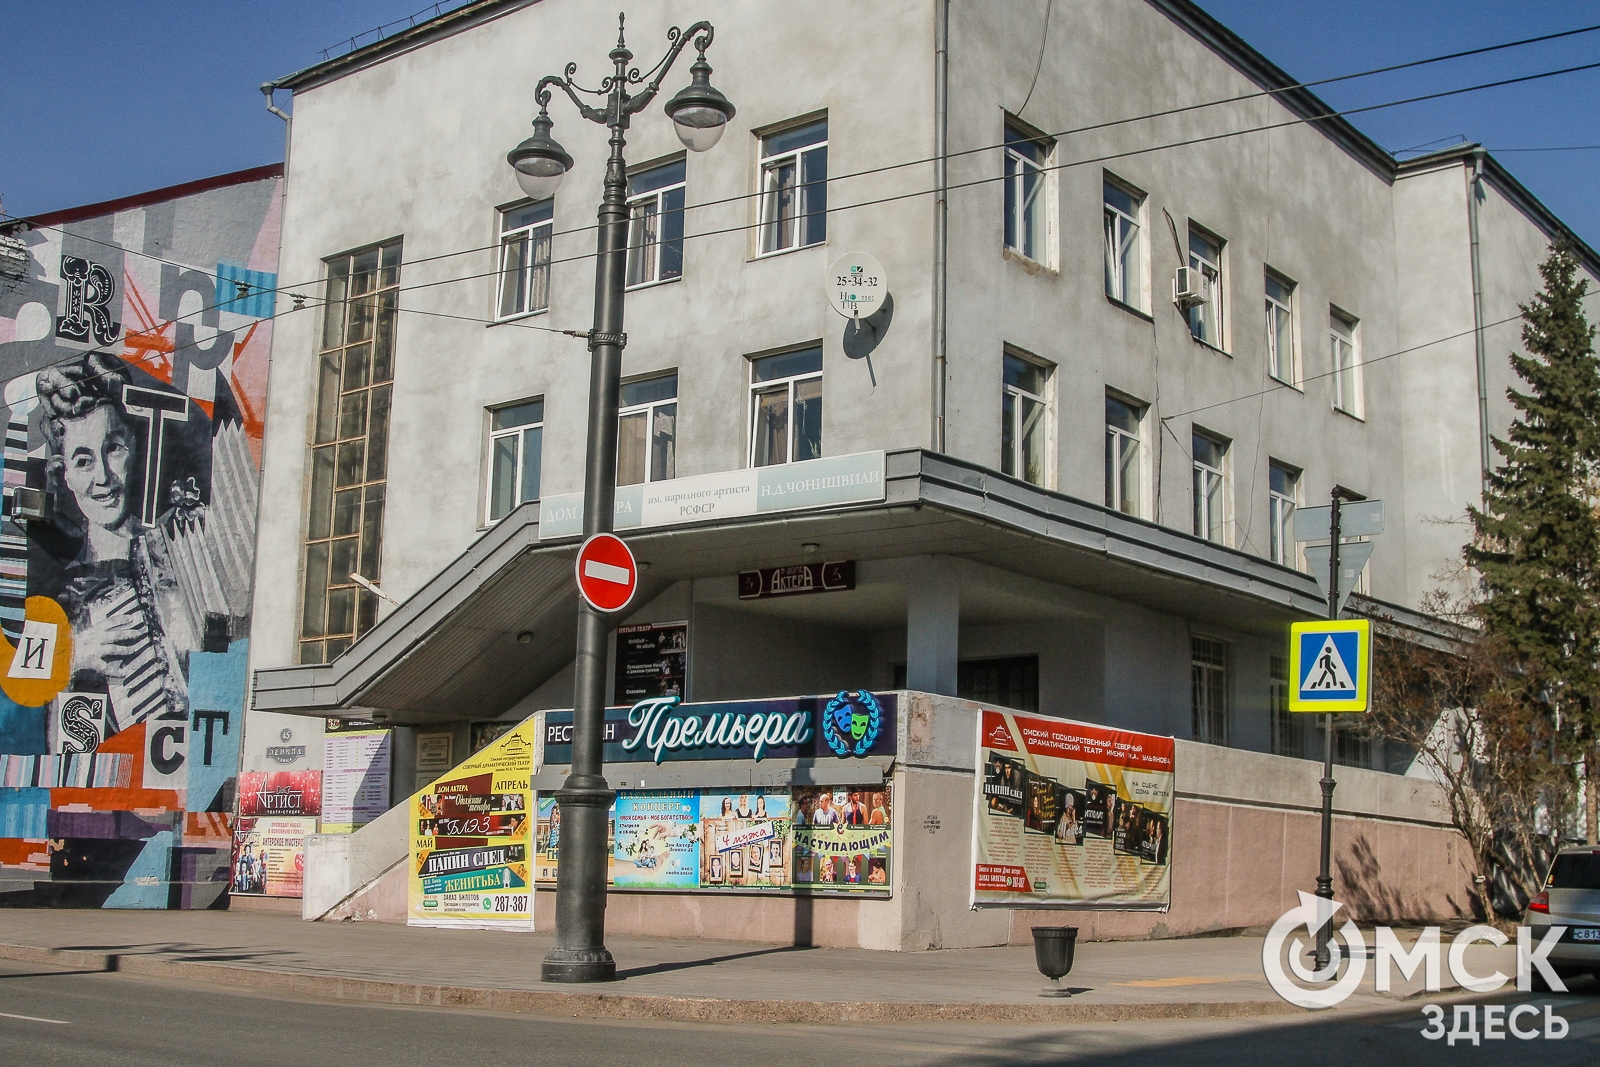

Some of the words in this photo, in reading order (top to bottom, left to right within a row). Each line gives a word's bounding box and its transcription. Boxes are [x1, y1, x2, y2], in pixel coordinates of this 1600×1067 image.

[60, 254, 121, 346] R
[760, 470, 880, 497] Н.Д.ЧОНИШВИЛИ
[648, 496, 662, 504] им.
[664, 489, 711, 504] народного
[713, 485, 750, 498] артиста
[545, 506, 577, 524] ДОМ
[679, 502, 715, 516] РСФСР
[618, 625, 636, 633] ПЯТЫЙ
[21, 637, 48, 669] И
[622, 696, 813, 766] Премьера
[1023, 728, 1049, 738] ОМСКИЙ
[1052, 732, 1112, 748] ГОСУДАРСТВЕННЫЙ
[1114, 742, 1143, 752] СЕВЕРНЫЙ
[1028, 738, 1080, 751] ДРАМАТИЧЕСКИЙ
[1083, 746, 1103, 755] ТЕАТР
[1106, 750, 1125, 758] ИМЕНИ
[1142, 754, 1171, 765] УЛЬЯНОВА
[437, 785, 449, 793] ДОМ
[494, 780, 528, 790] АПРЕЛЬ
[620, 790, 694, 800] ПАСХАЛЬНЫЙ
[632, 802, 681, 812] КОНЦЕРТ
[446, 816, 490, 835] БЛЭЗ
[416, 838, 432, 848] МАЙ
[722, 834, 730, 846] 4
[732, 828, 767, 847] мужа
[794, 831, 889, 851] НАСТУПАЮЩИМ
[428, 854, 469, 873] ПАПИН
[473, 849, 506, 868] СЛЕД
[444, 873, 501, 892] ЖЕНИТЬБА
[494, 896, 528, 912] 287-387
